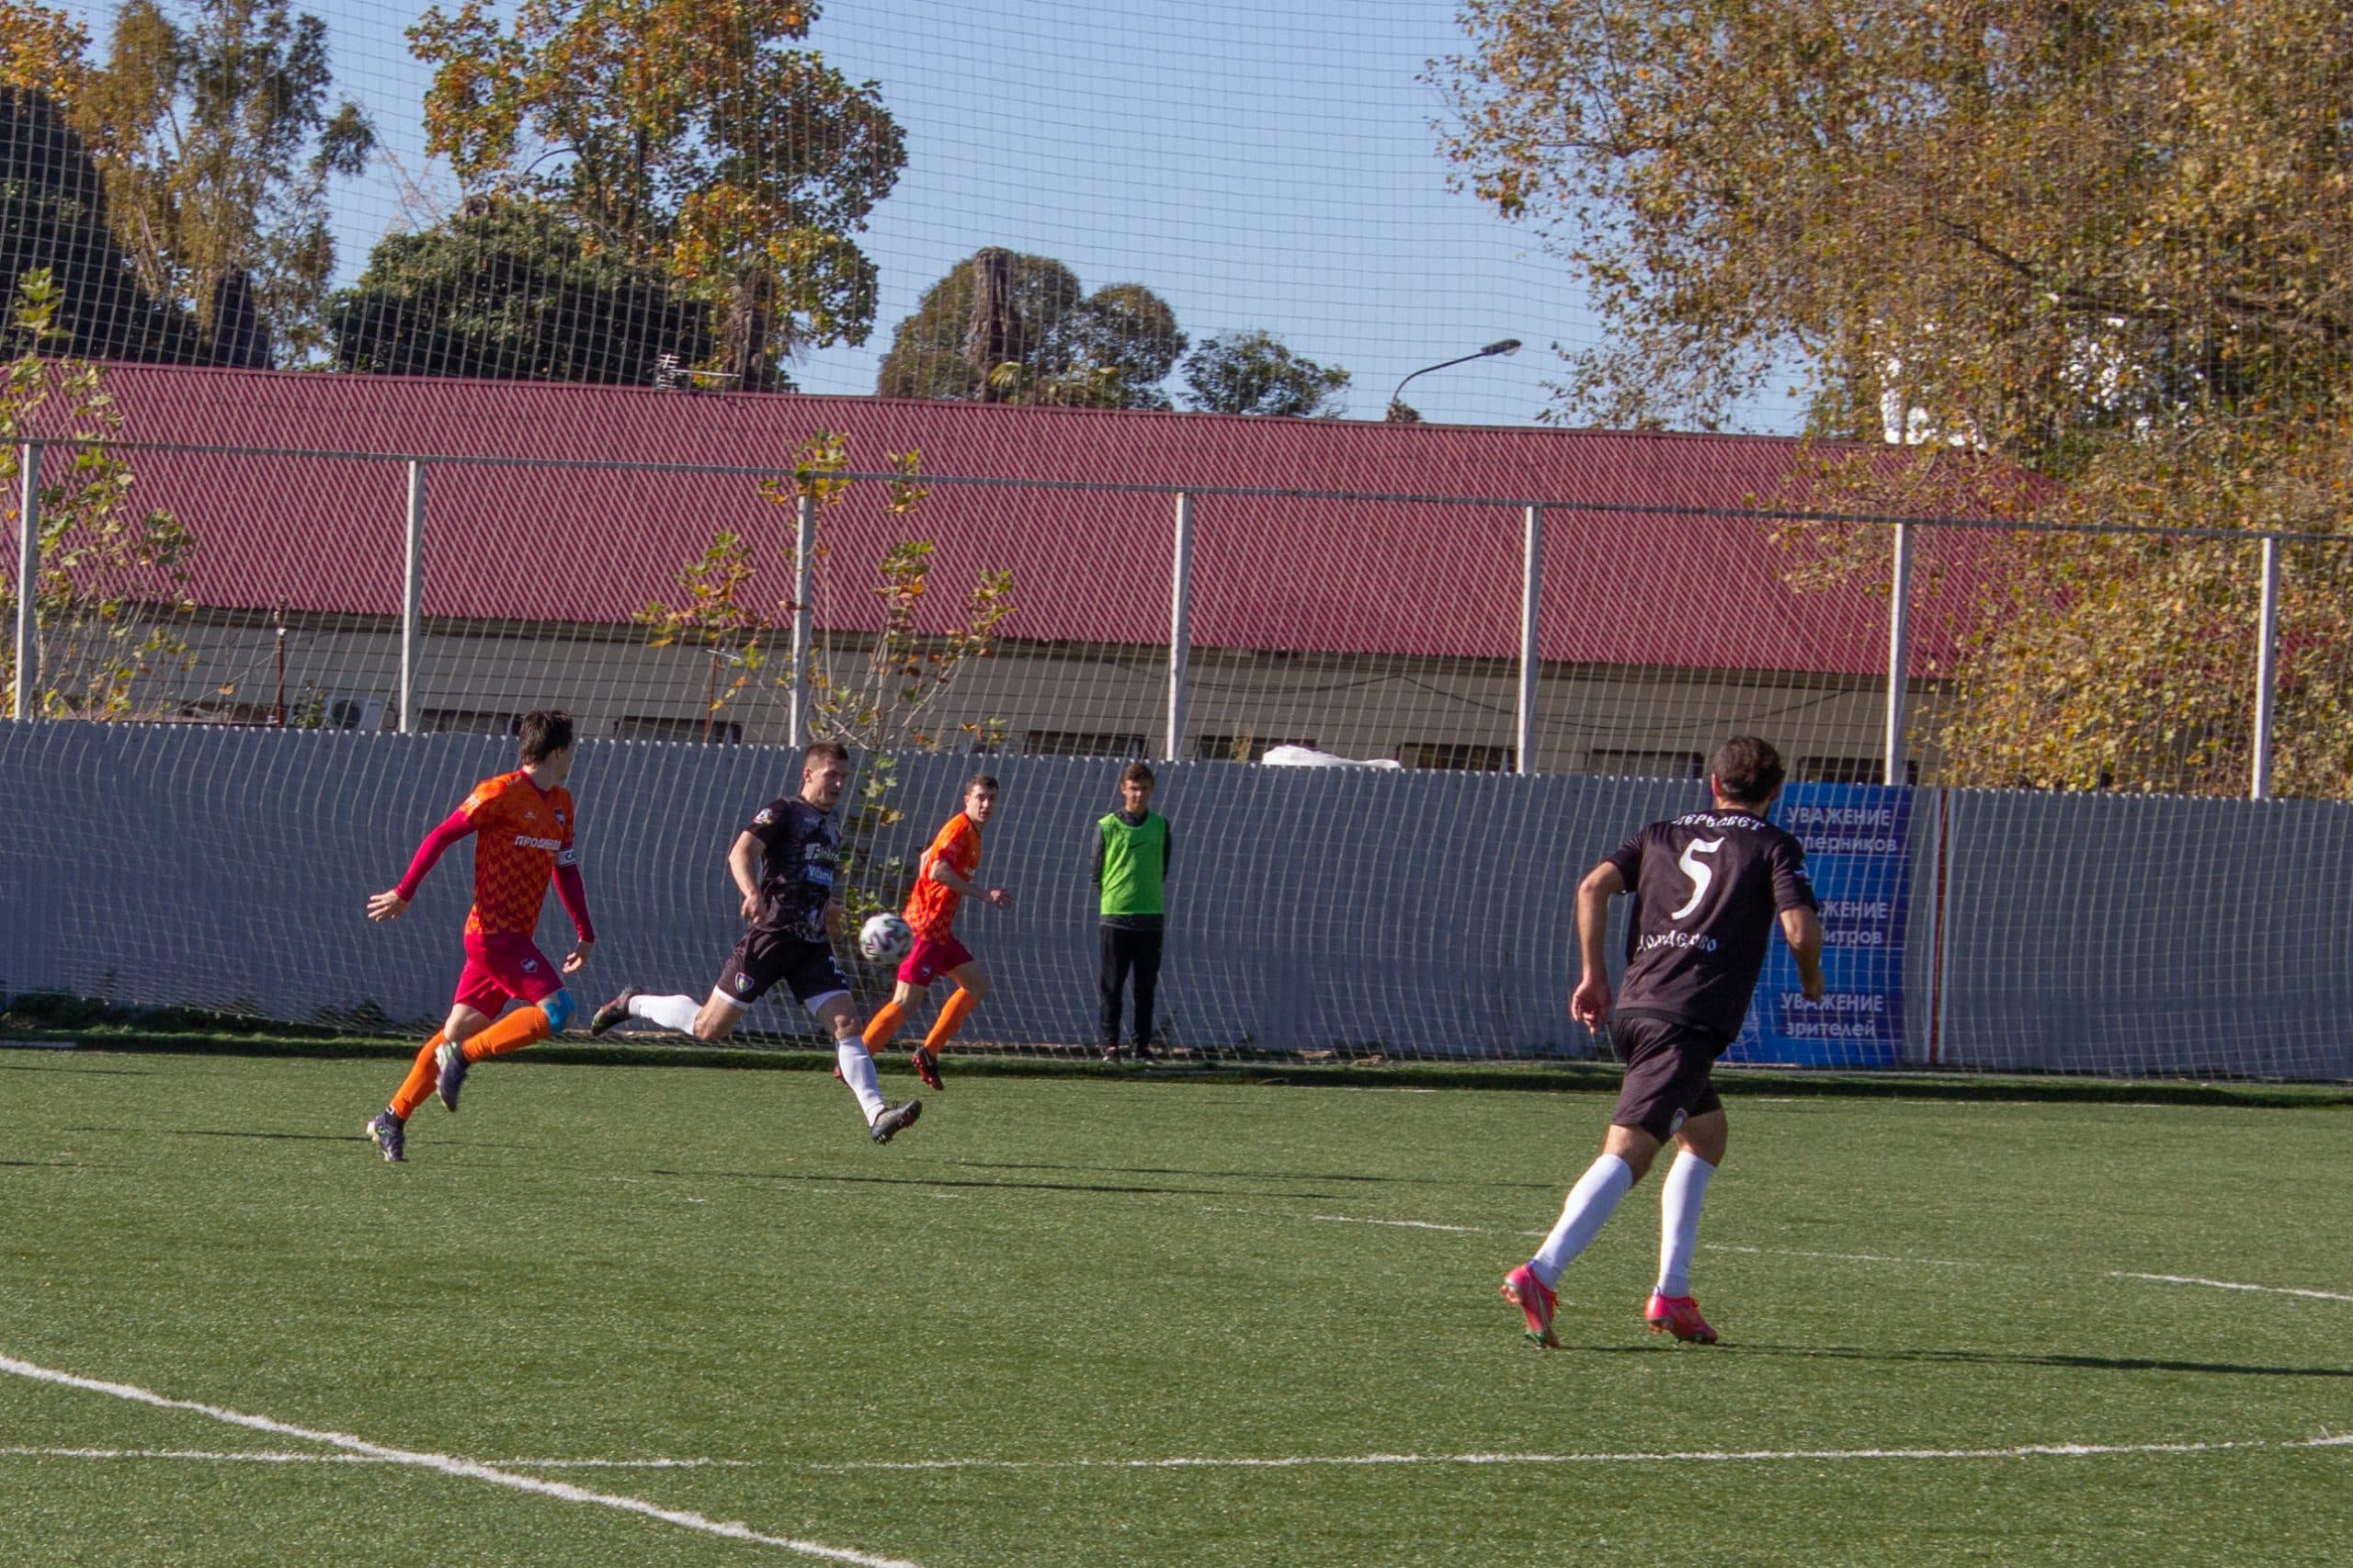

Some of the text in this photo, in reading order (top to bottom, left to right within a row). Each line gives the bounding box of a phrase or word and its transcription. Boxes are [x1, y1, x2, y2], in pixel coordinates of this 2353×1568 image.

[1787, 807, 1891, 826] УВАЖЕНИЕ
[1795, 835, 1897, 854] оперников
[1671, 836, 1725, 920] 5
[1818, 900, 1888, 918] ЖЕНИЕ
[1823, 930, 1882, 948] итров
[1786, 1020, 1876, 1039] зрителей
